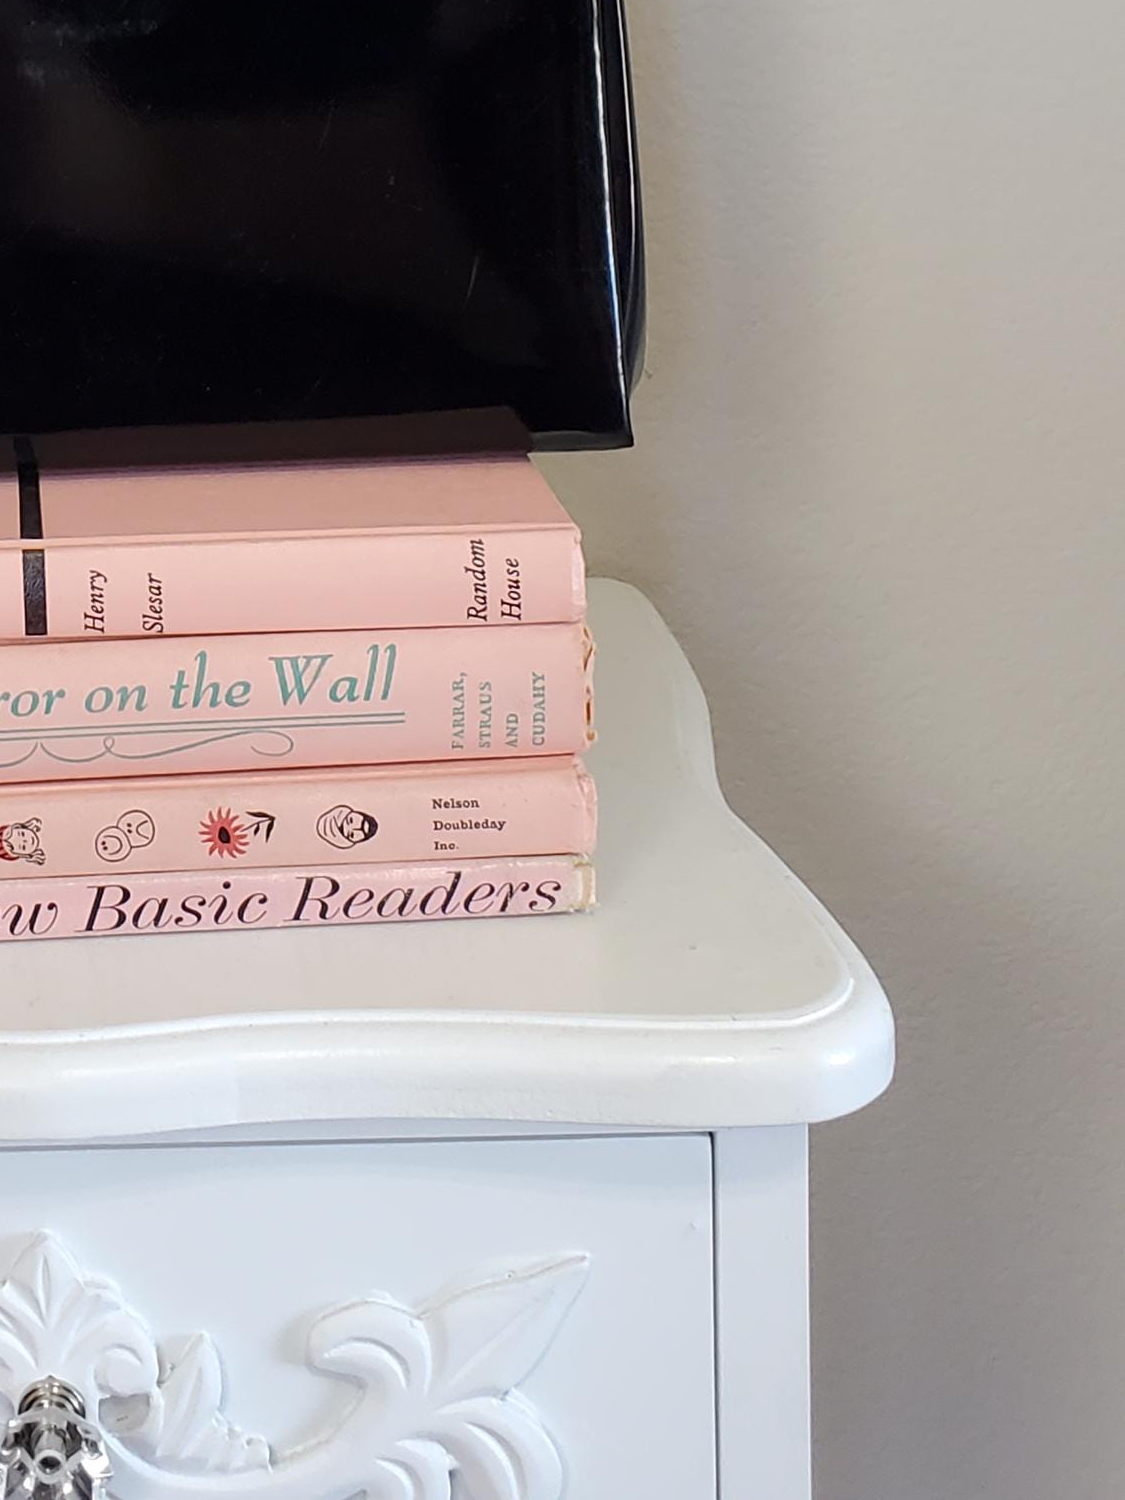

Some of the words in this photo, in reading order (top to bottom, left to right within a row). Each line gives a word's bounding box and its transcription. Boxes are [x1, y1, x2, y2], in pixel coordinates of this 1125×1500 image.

[83, 569, 108, 634] Henry
[142, 573, 165, 634] Slesar
[466, 538, 489, 622] Random
[500, 557, 523, 621] House
[83, 683, 148, 713] on
[169, 650, 252, 709] the
[268, 643, 398, 707] Wall
[531, 671, 547, 747] CUDAHY
[450, 672, 469, 750] FARRAR,
[478, 681, 492, 749] STRAUS
[505, 712, 520, 748] AND
[431, 797, 480, 810] Nelson
[433, 818, 507, 833] Doubleday
[433, 840, 460, 852] Inc.
[74, 880, 269, 934] Basic
[282, 870, 564, 923] Readers
